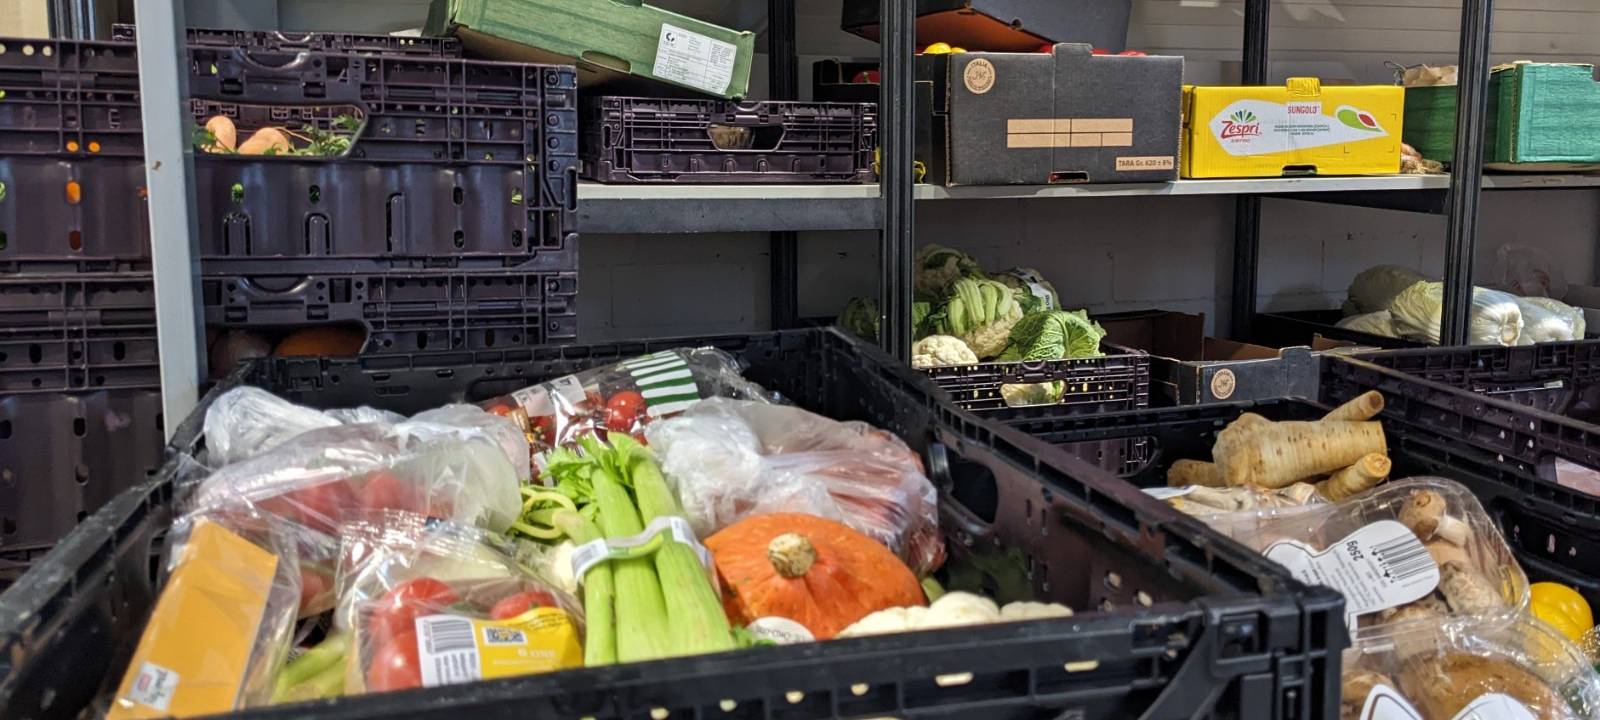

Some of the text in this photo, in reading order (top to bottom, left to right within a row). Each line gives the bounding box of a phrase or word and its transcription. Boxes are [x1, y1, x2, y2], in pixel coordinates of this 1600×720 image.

[1221, 121, 1260, 139] Zespri
[1119, 159, 1135, 167] TARA
[1346, 540, 1364, 562] 250g
